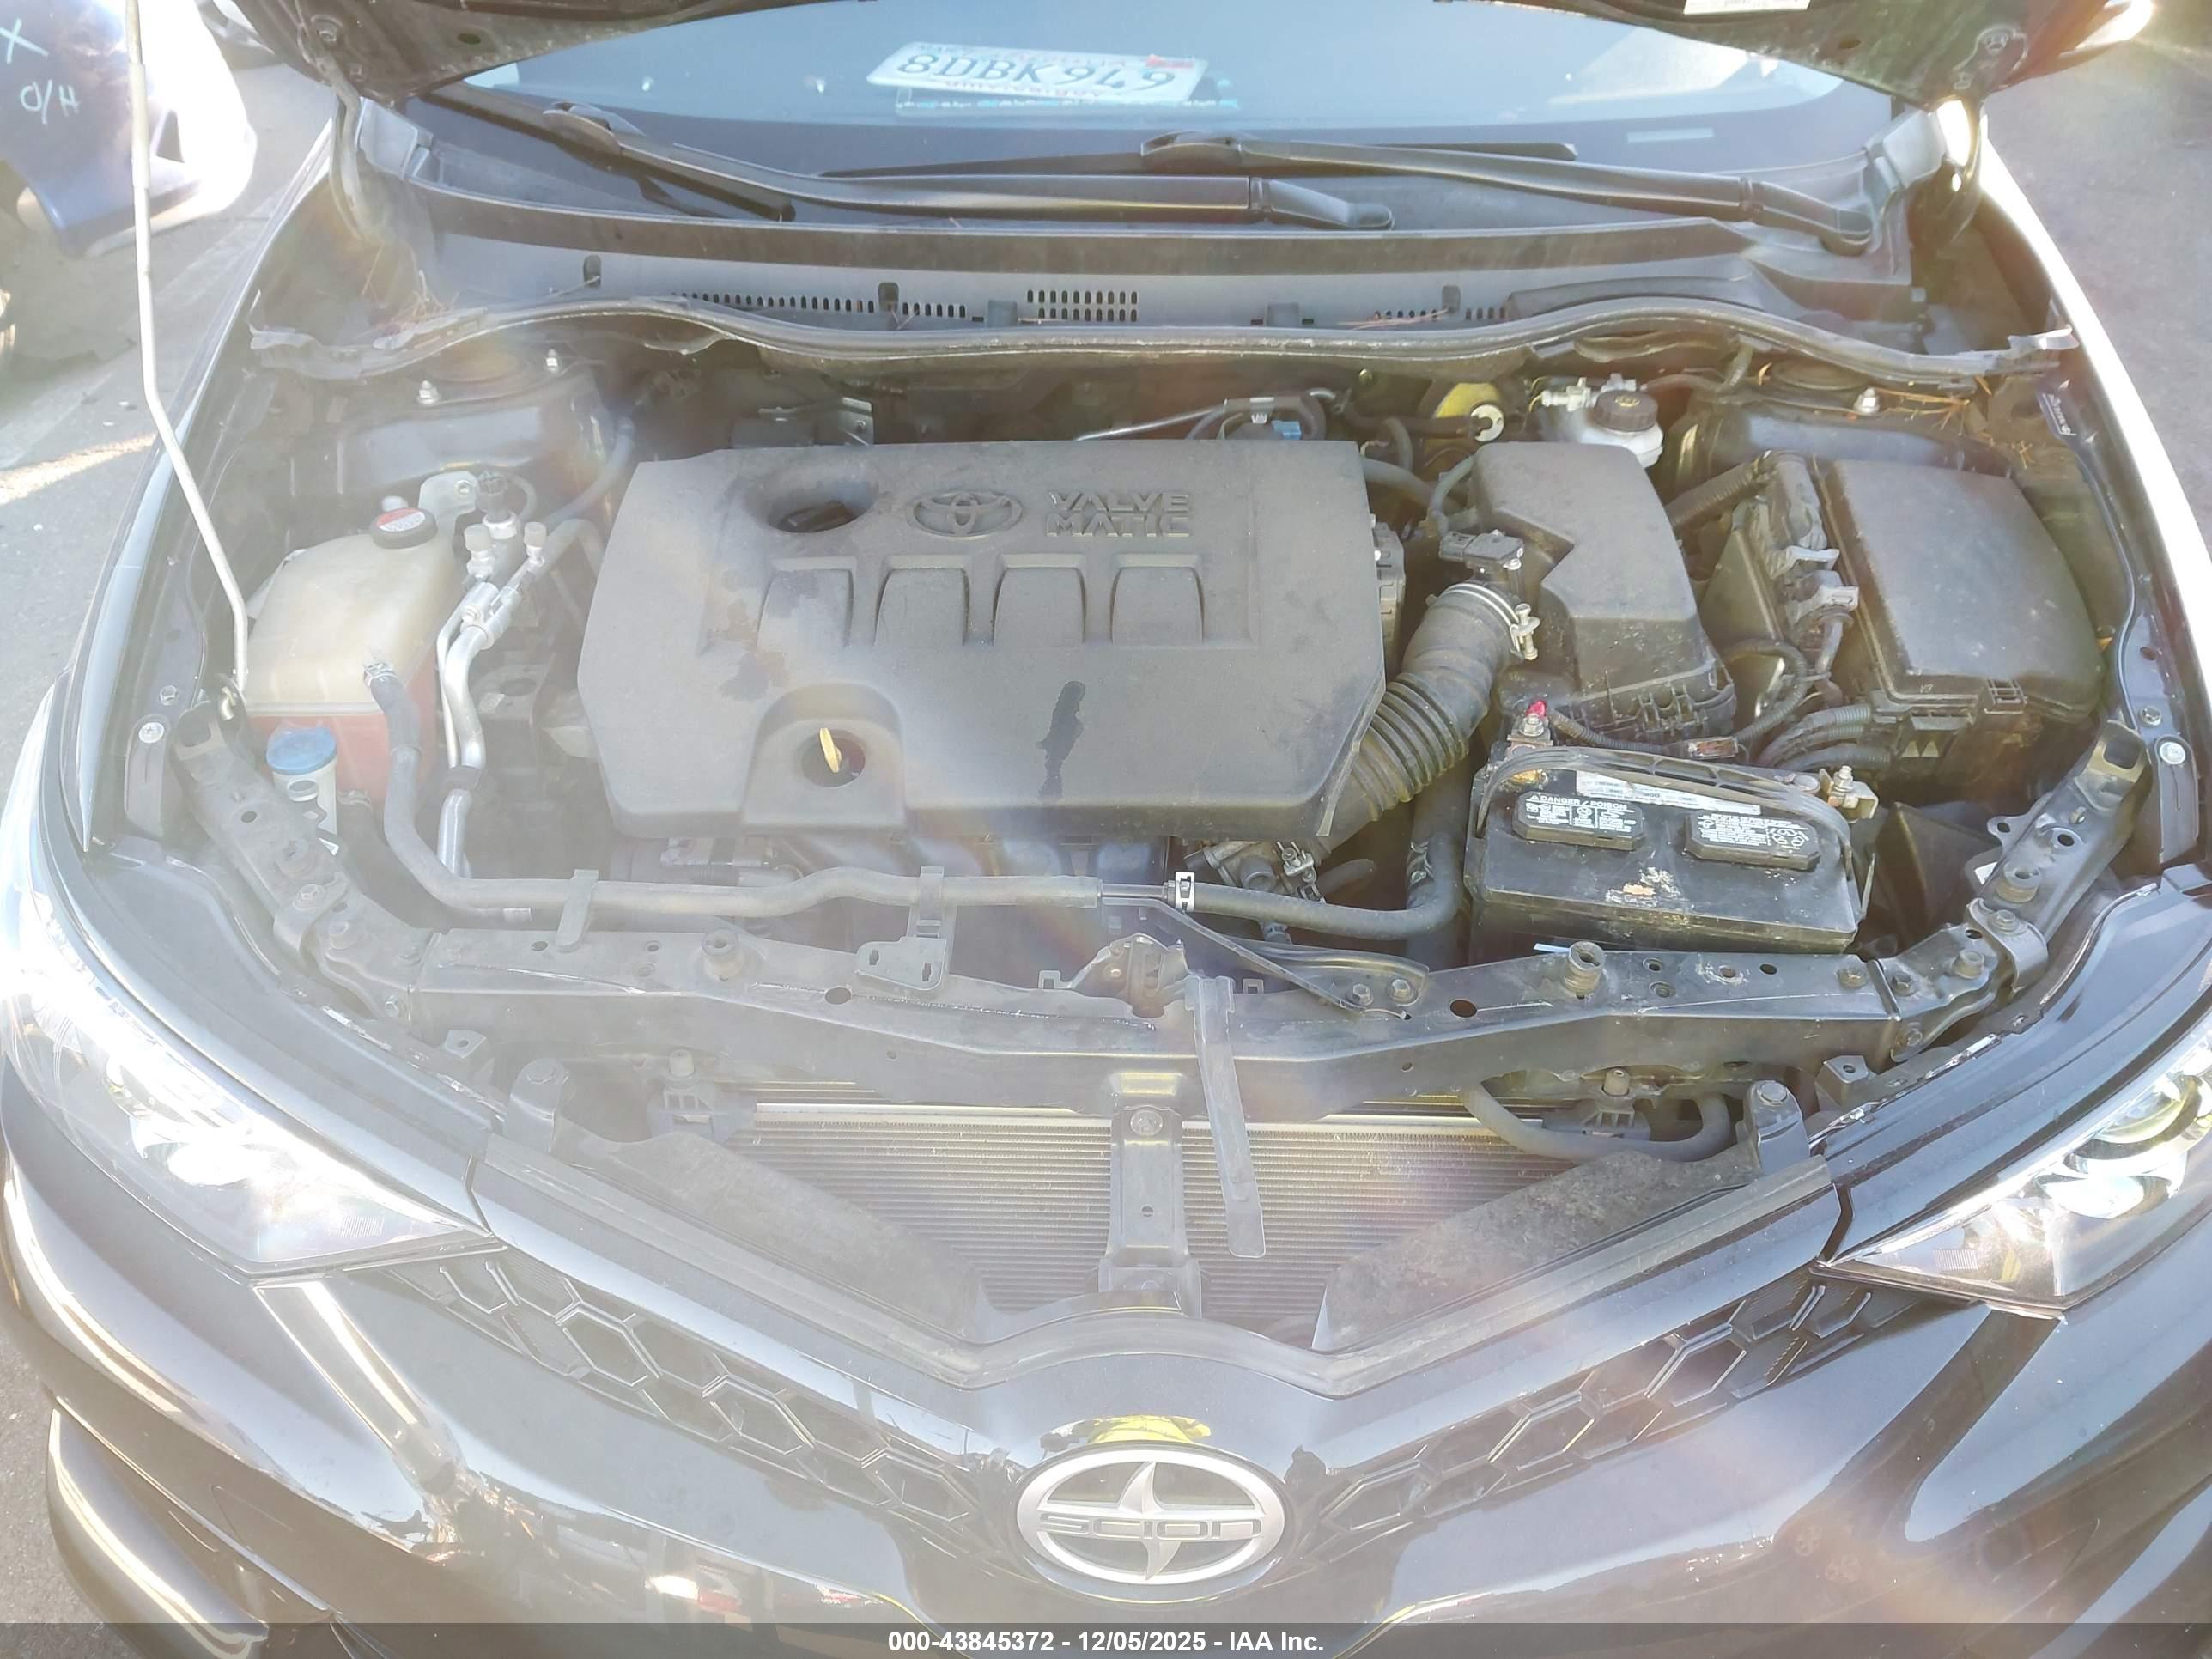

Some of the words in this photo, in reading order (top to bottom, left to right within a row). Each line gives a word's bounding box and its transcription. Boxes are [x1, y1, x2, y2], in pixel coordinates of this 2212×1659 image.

[897, 54, 1176, 91] 8DBK949
[20, 79, 81, 125] O/H
[1048, 492, 1189, 514] VALVE
[1046, 514, 1190, 538] MATIC
[1540, 795, 1581, 806] DANGER
[1590, 800, 1628, 811] POISON
